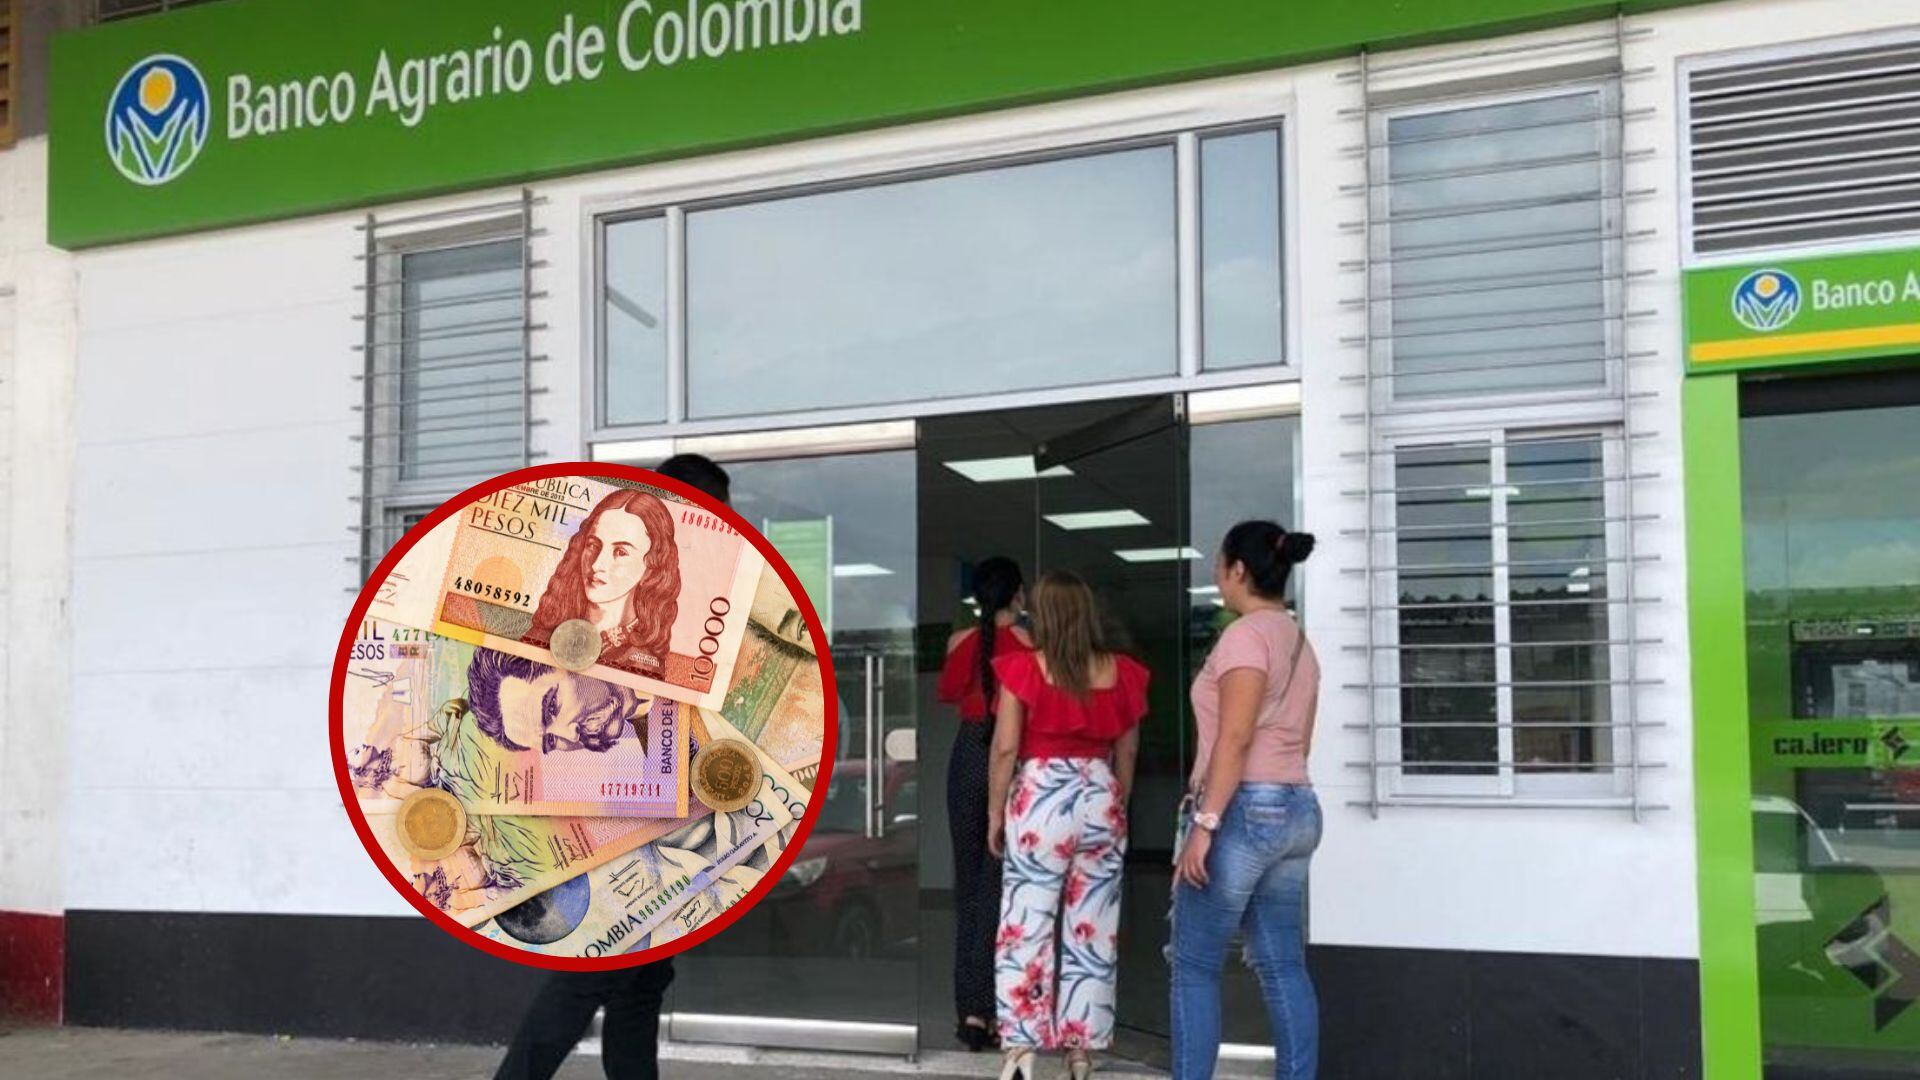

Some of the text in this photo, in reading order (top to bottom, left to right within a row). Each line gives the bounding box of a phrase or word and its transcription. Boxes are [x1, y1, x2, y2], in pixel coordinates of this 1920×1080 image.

[227, 0, 862, 139] Banco Agrario de Colombia
[1812, 279, 1895, 311] Banco
[1773, 731, 1868, 756] cajero
